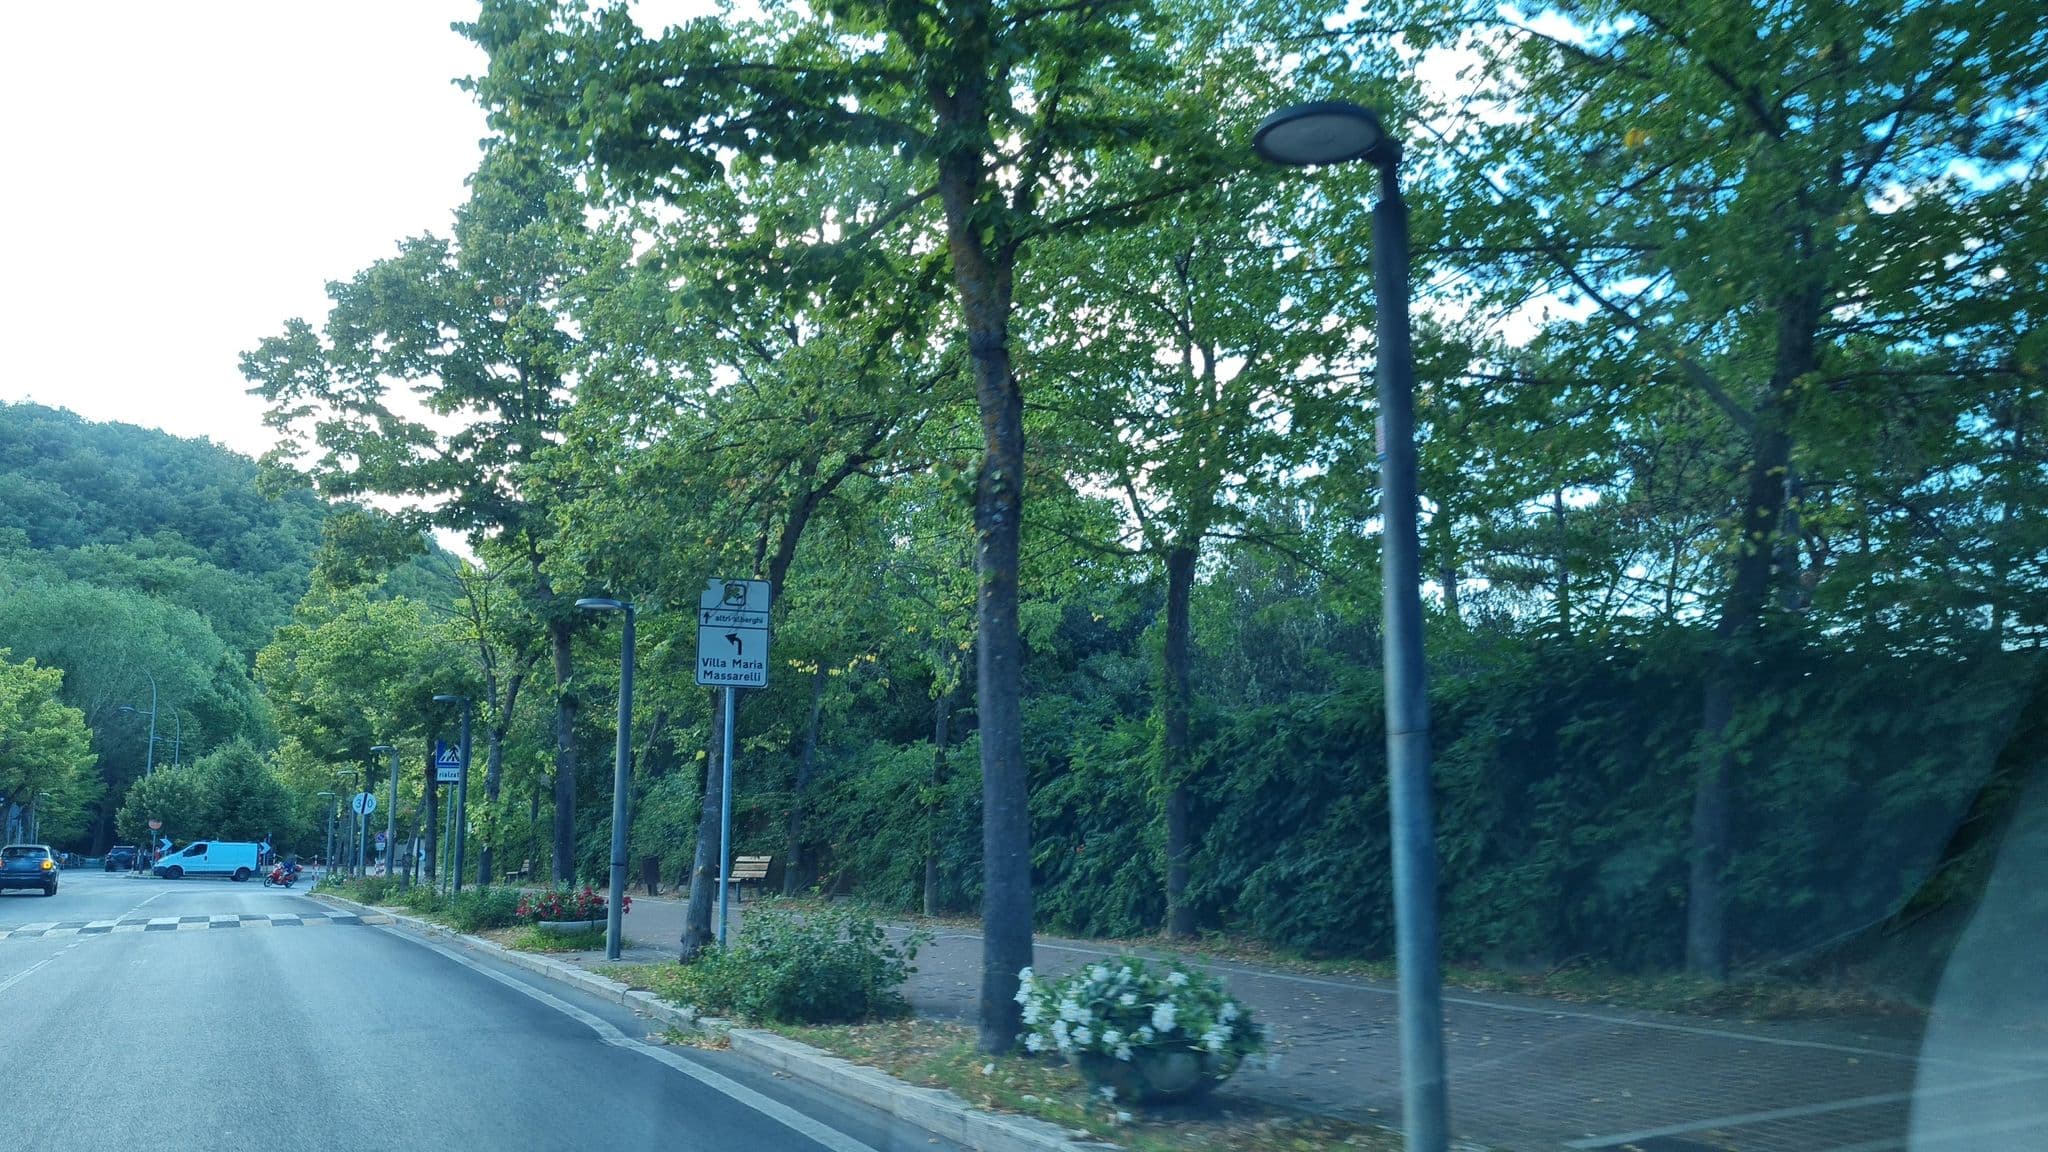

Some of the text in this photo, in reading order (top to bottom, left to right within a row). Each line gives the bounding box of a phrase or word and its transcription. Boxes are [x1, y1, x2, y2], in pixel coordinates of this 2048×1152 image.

[733, 615, 763, 624] alberghi
[702, 658, 763, 669] Villa Maria
[703, 670, 761, 681] Massarelli
